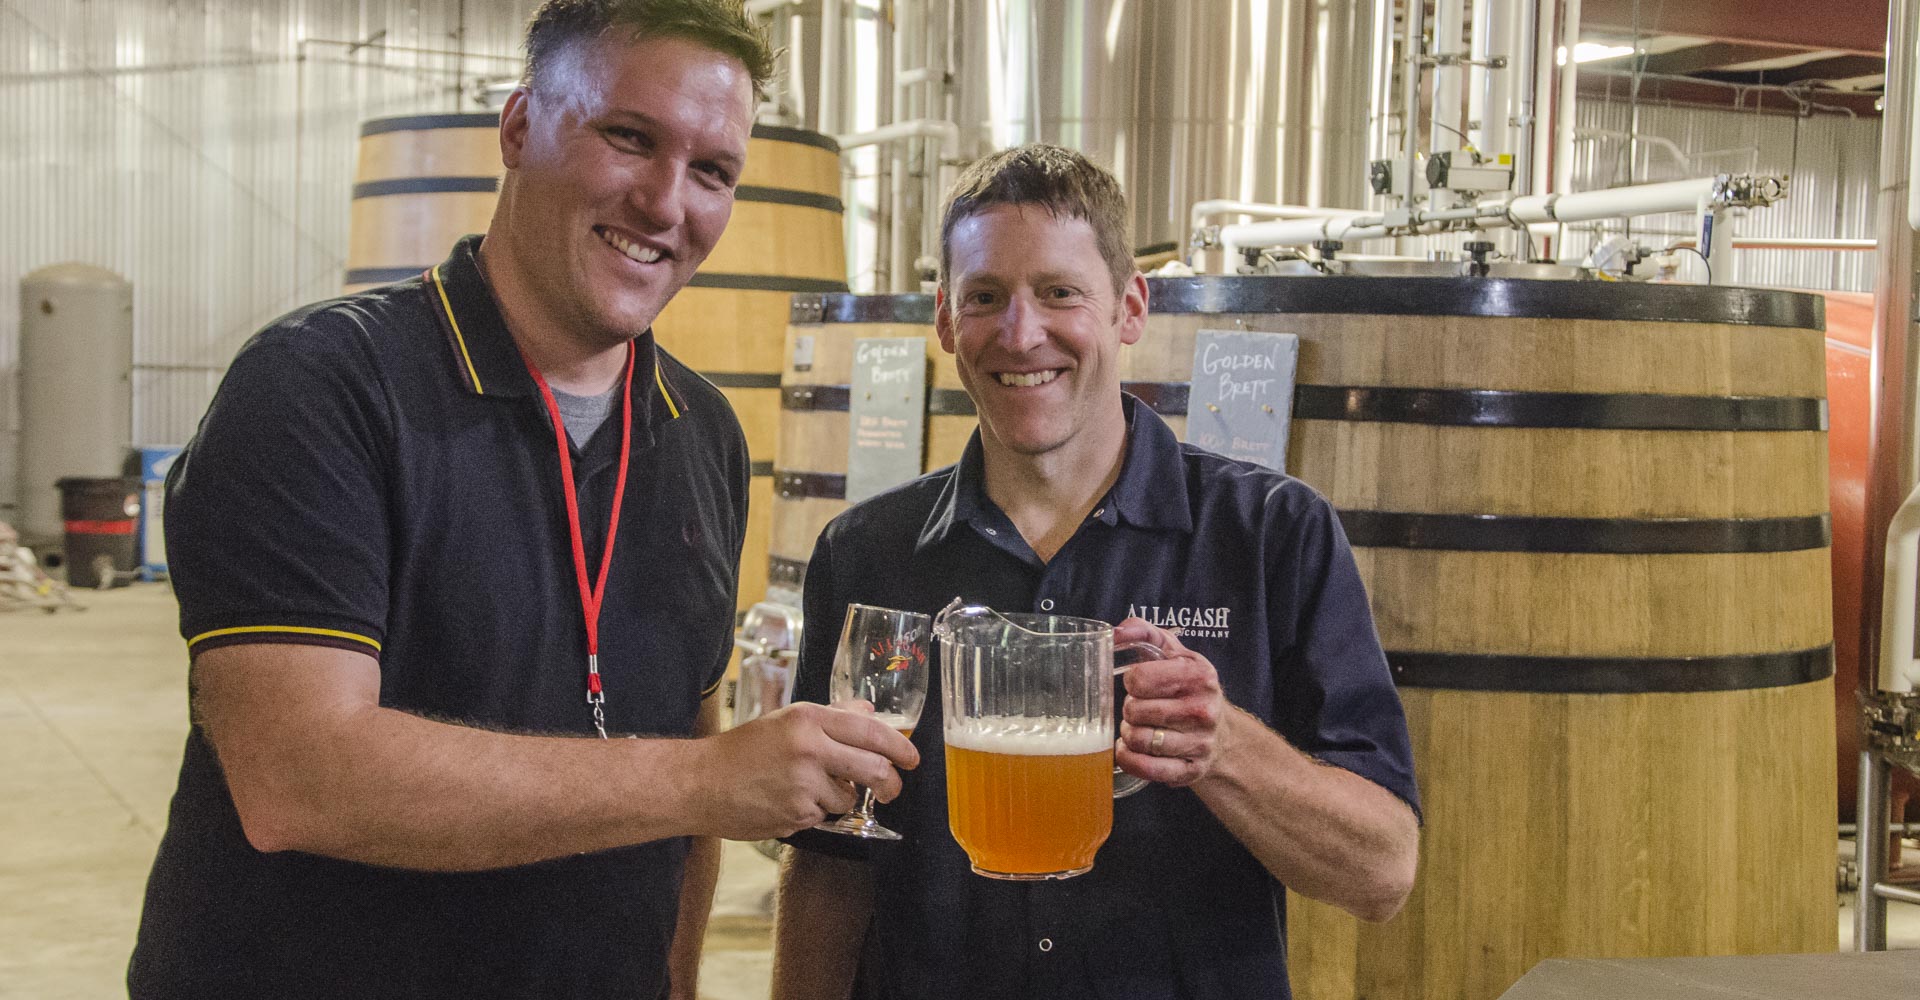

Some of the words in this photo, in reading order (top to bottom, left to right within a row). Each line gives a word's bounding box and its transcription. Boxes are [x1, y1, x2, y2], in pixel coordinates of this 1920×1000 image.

[1202, 342, 1280, 376] GOLDEN
[1219, 372, 1276, 401] BRETT
[1127, 603, 1231, 628] ALLAGASH
[1184, 629, 1230, 638] COMPANY
